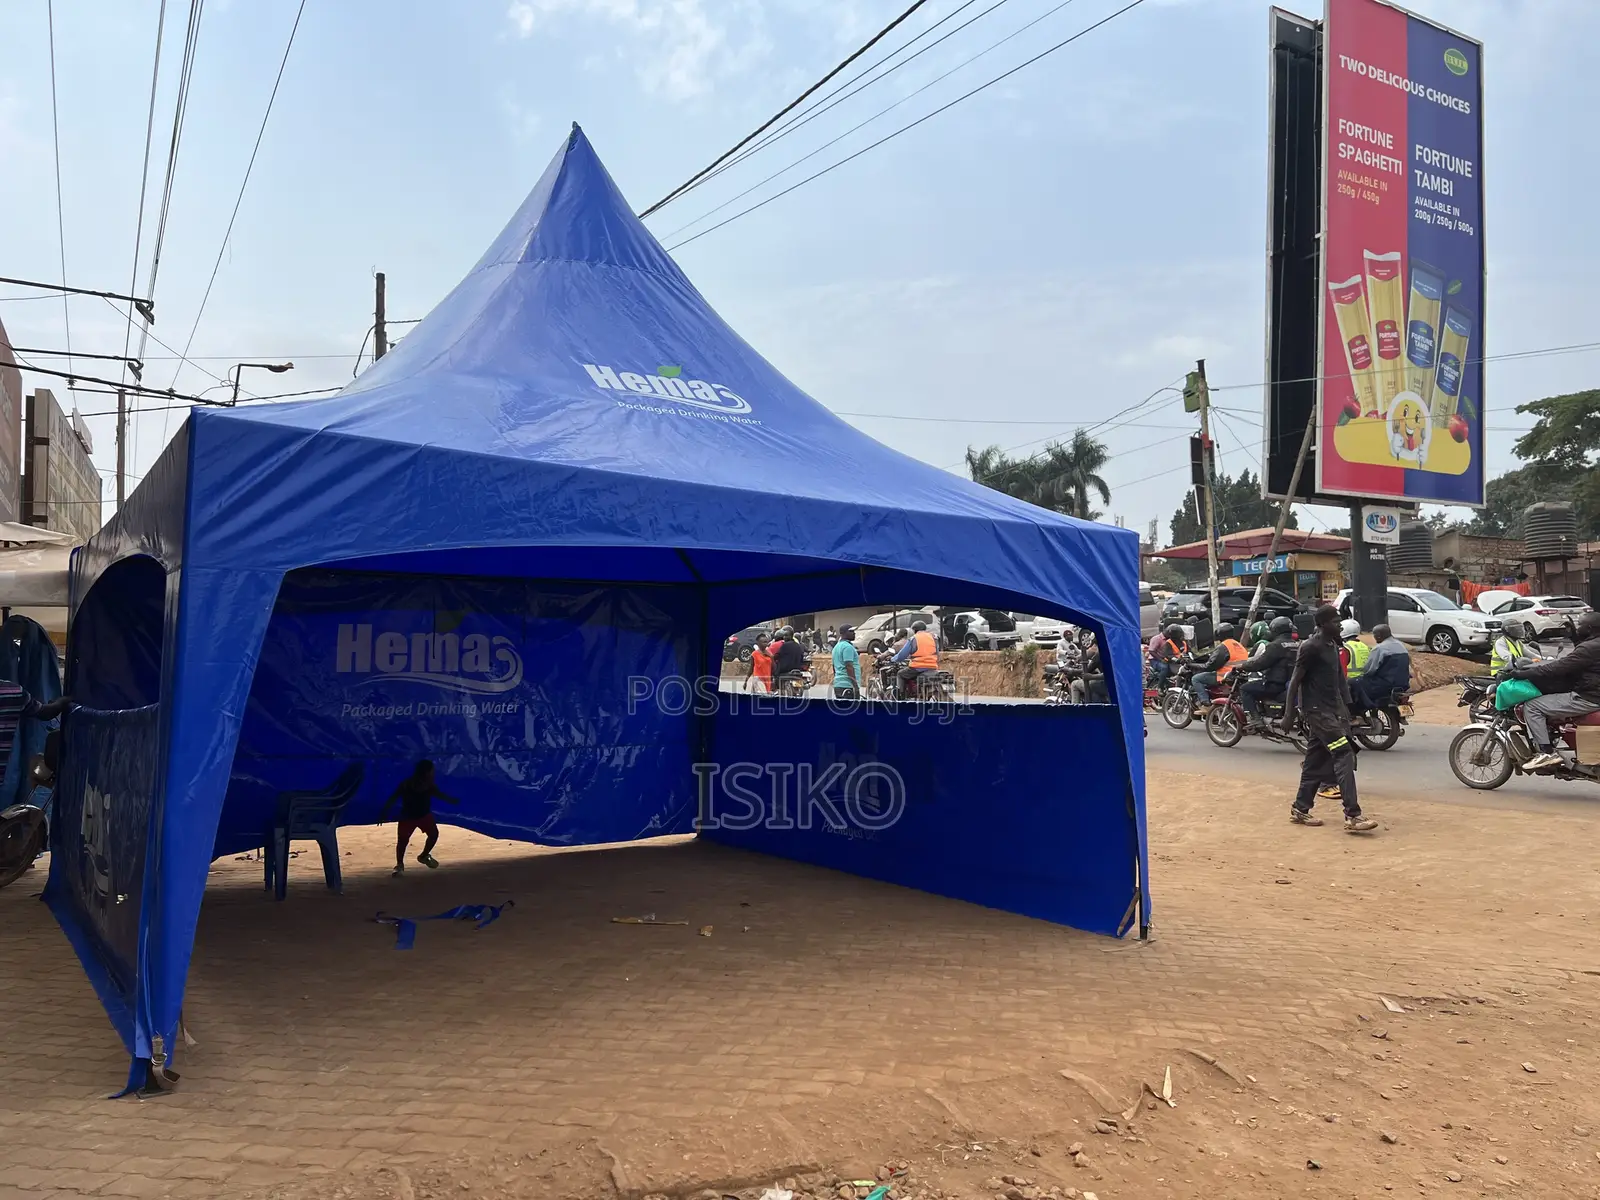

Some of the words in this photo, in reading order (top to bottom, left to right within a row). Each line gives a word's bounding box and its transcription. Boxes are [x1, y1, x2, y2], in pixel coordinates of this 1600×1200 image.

[1339, 54, 1367, 75] TWO
[1368, 65, 1425, 97] DELICIOUS
[1426, 88, 1470, 114] CHOICES
[1339, 118, 1393, 150] FORTUNE
[1338, 142, 1402, 176] SPAGHETTI
[1415, 144, 1472, 178] FORTUNE
[1338, 169, 1378, 189] AVAILABLE
[1380, 181, 1388, 192] IN
[1338, 183, 1355, 198] 250g
[1356, 188, 1361, 199] /
[1362, 190, 1380, 205] 450g
[1414, 169, 1453, 197] TAMBI
[1415, 196, 1451, 215] AVAILABLE
[1453, 206, 1460, 217] IN
[1415, 209, 1431, 224] 200g
[1437, 215, 1453, 230] 250g
[1458, 221, 1474, 236] 500g
[1411, 332, 1434, 347] FORTUNE
[582, 364, 721, 402] Hema
[617, 401, 676, 415] Packaged
[678, 408, 729, 423] Drinking
[729, 415, 762, 426] Water
[1243, 559, 1283, 572] TECO
[336, 624, 490, 672] Hema
[341, 703, 412, 719] Packaged
[417, 702, 477, 717] Drinking
[481, 701, 520, 714] Water
